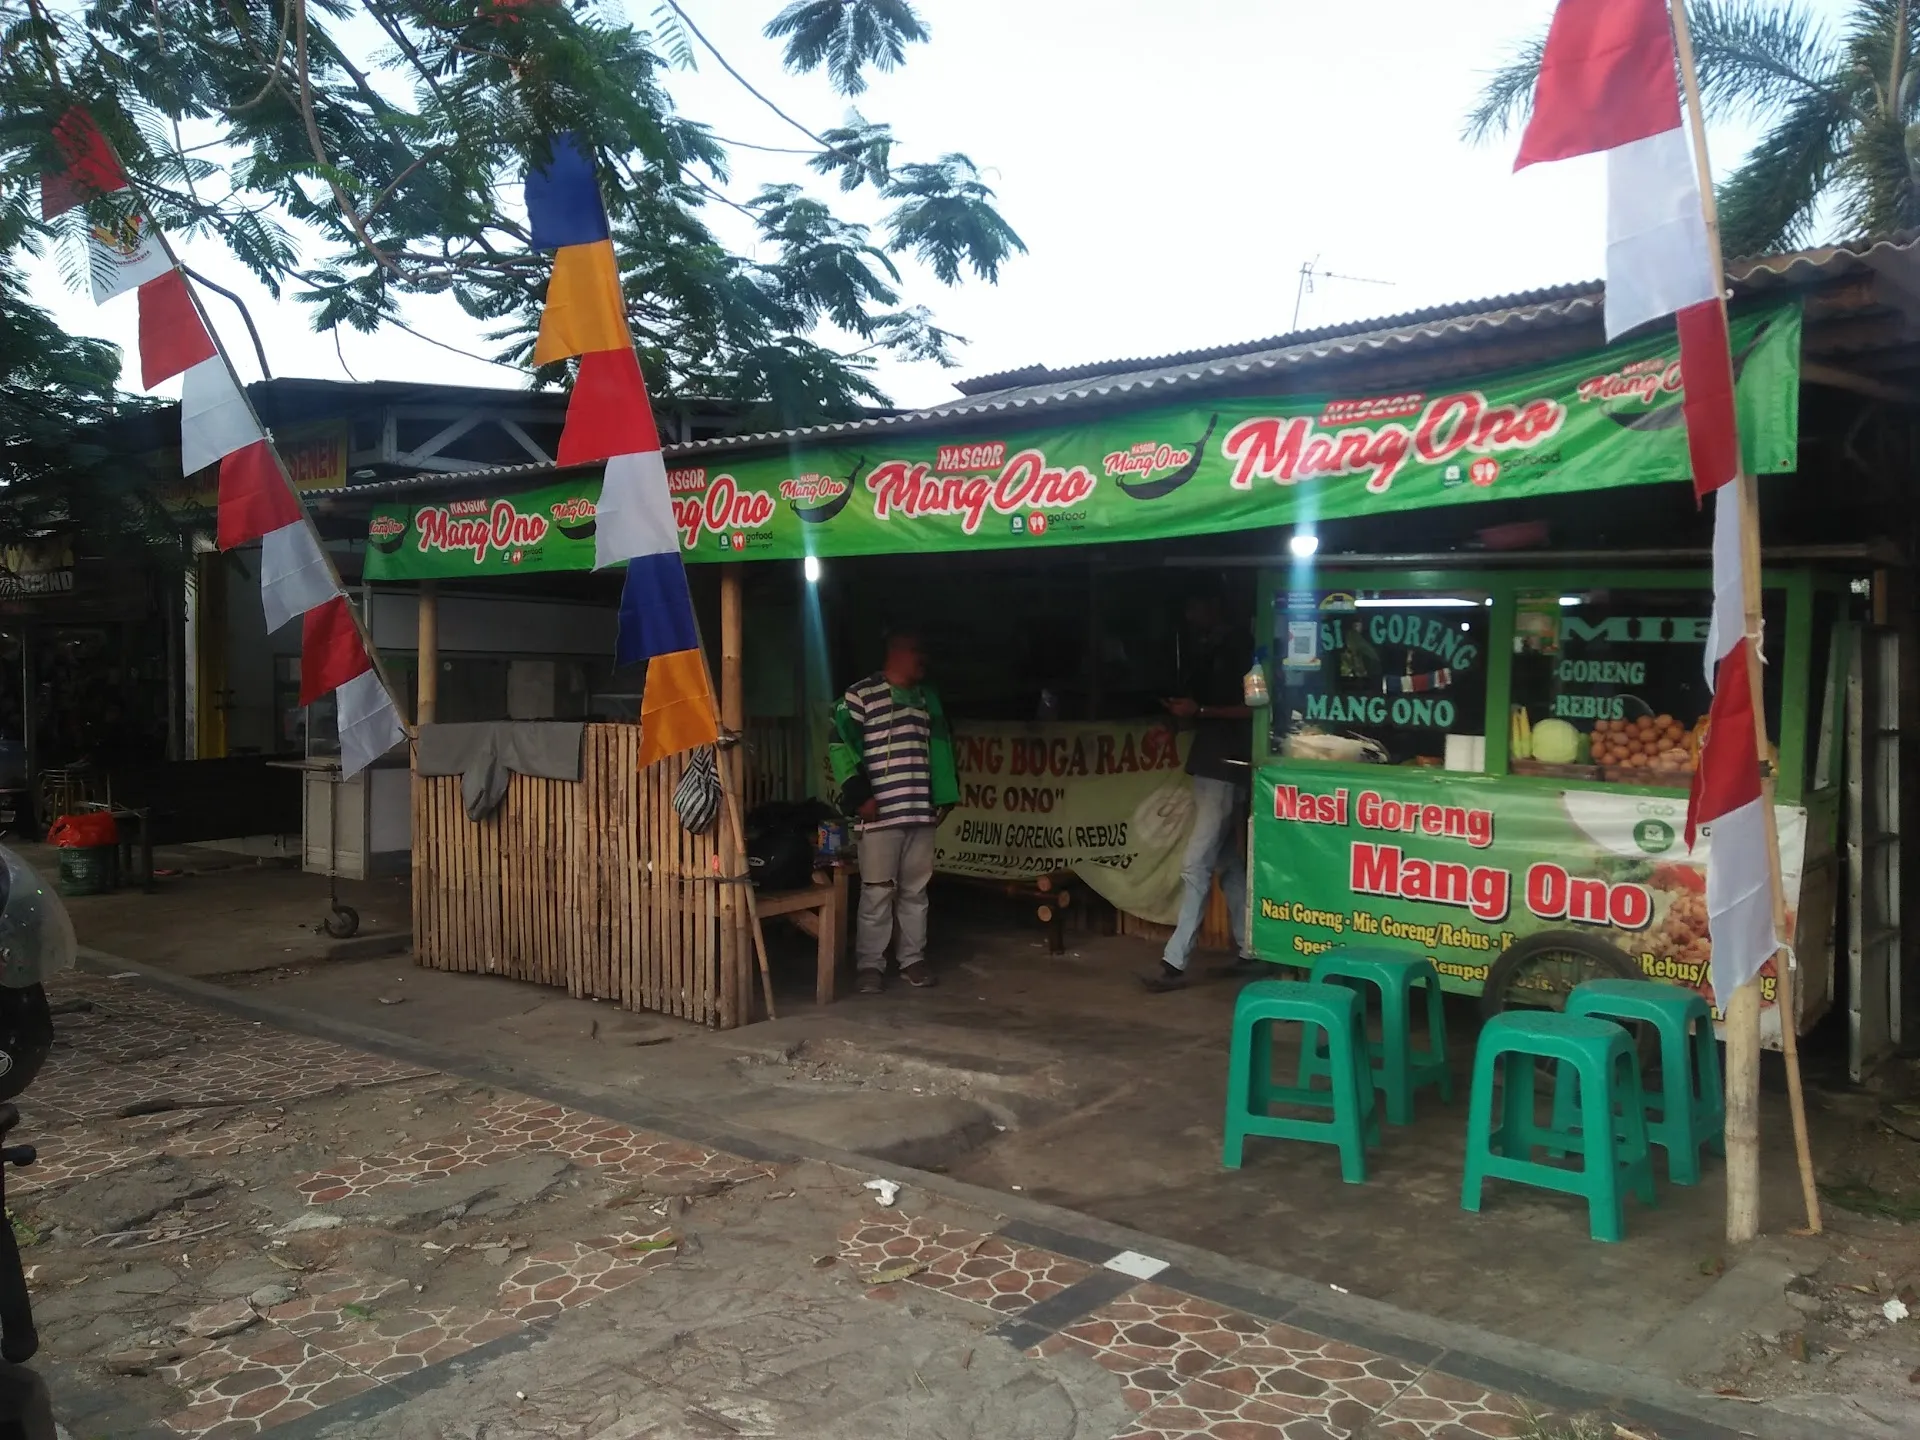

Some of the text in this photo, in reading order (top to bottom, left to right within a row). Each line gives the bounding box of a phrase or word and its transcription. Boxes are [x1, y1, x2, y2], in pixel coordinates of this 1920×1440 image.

[1577, 373, 1661, 404] Mang
[938, 443, 1005, 471] NASGOR
[1222, 390, 1565, 493] Mang Ono
[1103, 444, 1190, 478] Mang Ono
[668, 468, 705, 491] ASGOR
[780, 476, 846, 504] Mang Ono
[866, 449, 1097, 535] Mang Ono
[578, 499, 597, 518] On
[672, 474, 775, 549] ng Ono
[1047, 510, 1087, 525] gofood
[416, 500, 548, 564] Mang Ono
[746, 531, 773, 541] gofood
[1320, 614, 1478, 670] SI GORENG
[1560, 616, 1712, 643] MIE
[1306, 694, 1455, 728] MANG ONO
[955, 732, 1181, 777] ENG BOGA RASA
[956, 784, 997, 809] NG
[1274, 784, 1494, 848] Nasi Goreng
[1005, 823, 1063, 849] GORENG
[1076, 823, 1129, 848] REBUS
[1350, 841, 1651, 929] Mang Ono
[1261, 899, 1290, 921] Nasi
[1292, 903, 1344, 933] Goreng
[1352, 911, 1378, 935] Mie
[1381, 919, 1490, 951] Goreng/Rebus
